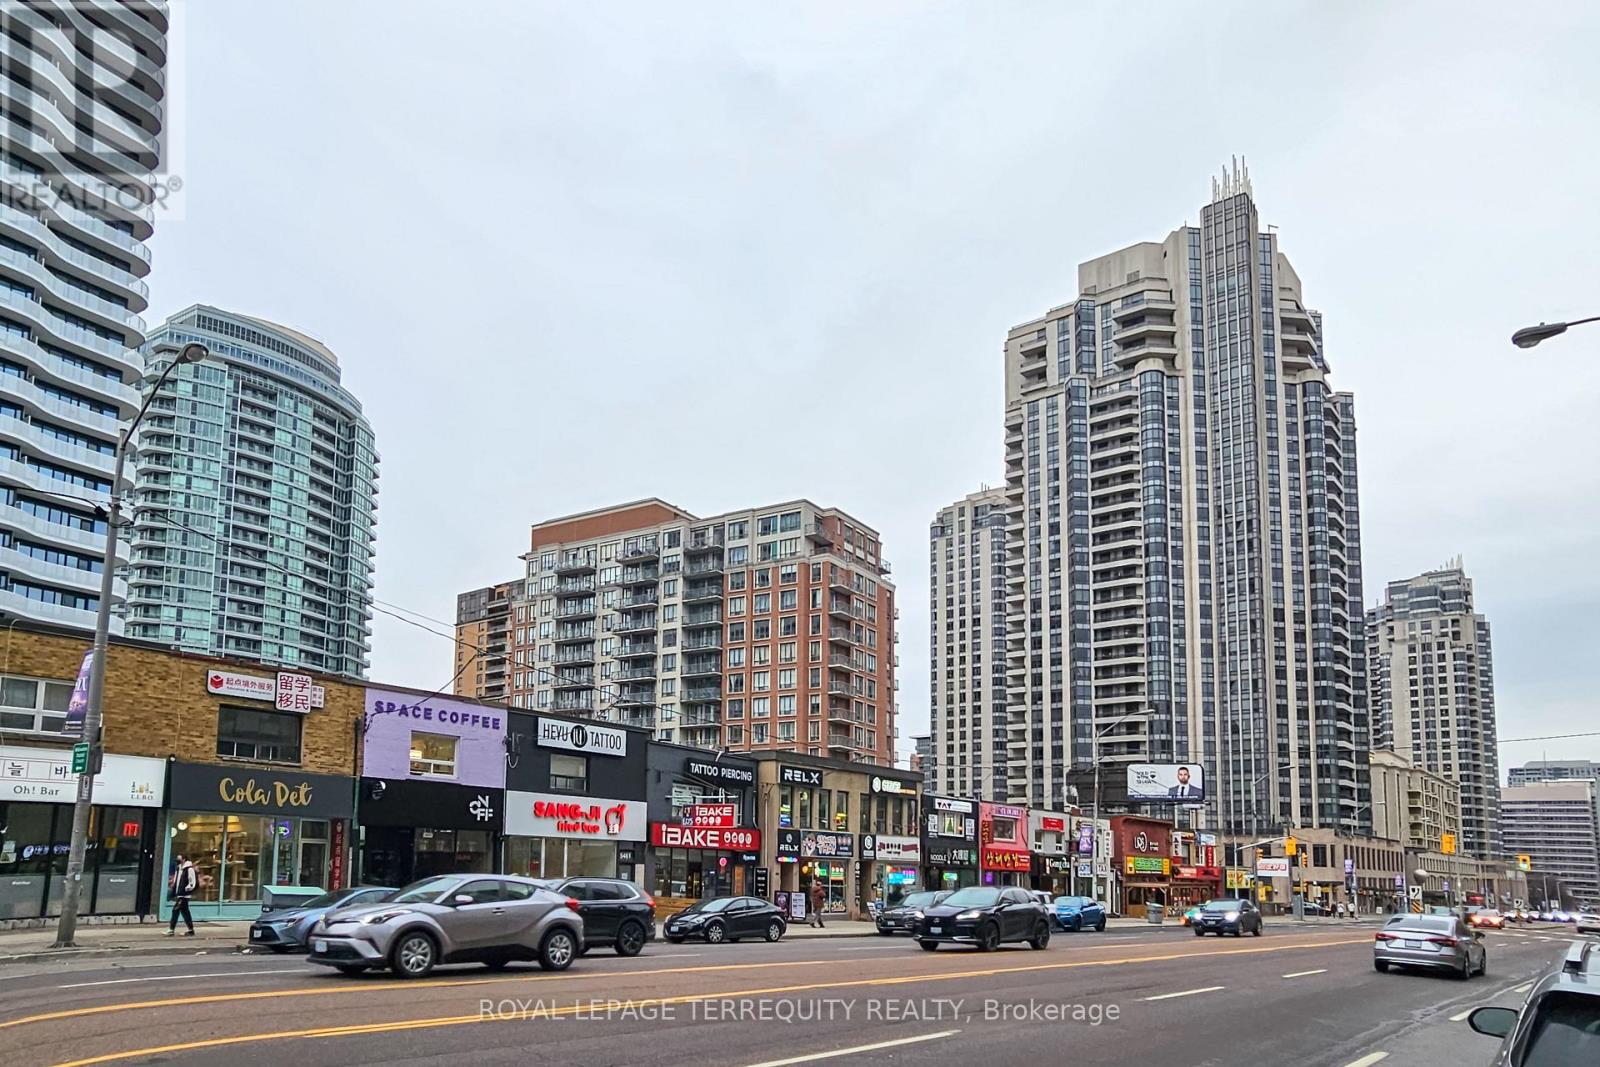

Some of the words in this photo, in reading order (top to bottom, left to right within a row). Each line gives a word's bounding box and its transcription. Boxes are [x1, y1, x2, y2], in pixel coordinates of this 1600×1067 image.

[374, 700, 433, 720] SPACE
[438, 710, 500, 729] COFFEE
[543, 723, 569, 741] HEYU
[590, 731, 622, 750] TATTOO
[690, 763, 718, 776] TATTOO
[721, 768, 752, 781] PIERCING
[784, 769, 819, 784] RELX
[13, 785, 36, 795] Oh!
[40, 786, 60, 796] Bar
[220, 778, 271, 805] Cola
[696, 806, 733, 816] iBAKE
[662, 824, 720, 847] iBAKE
